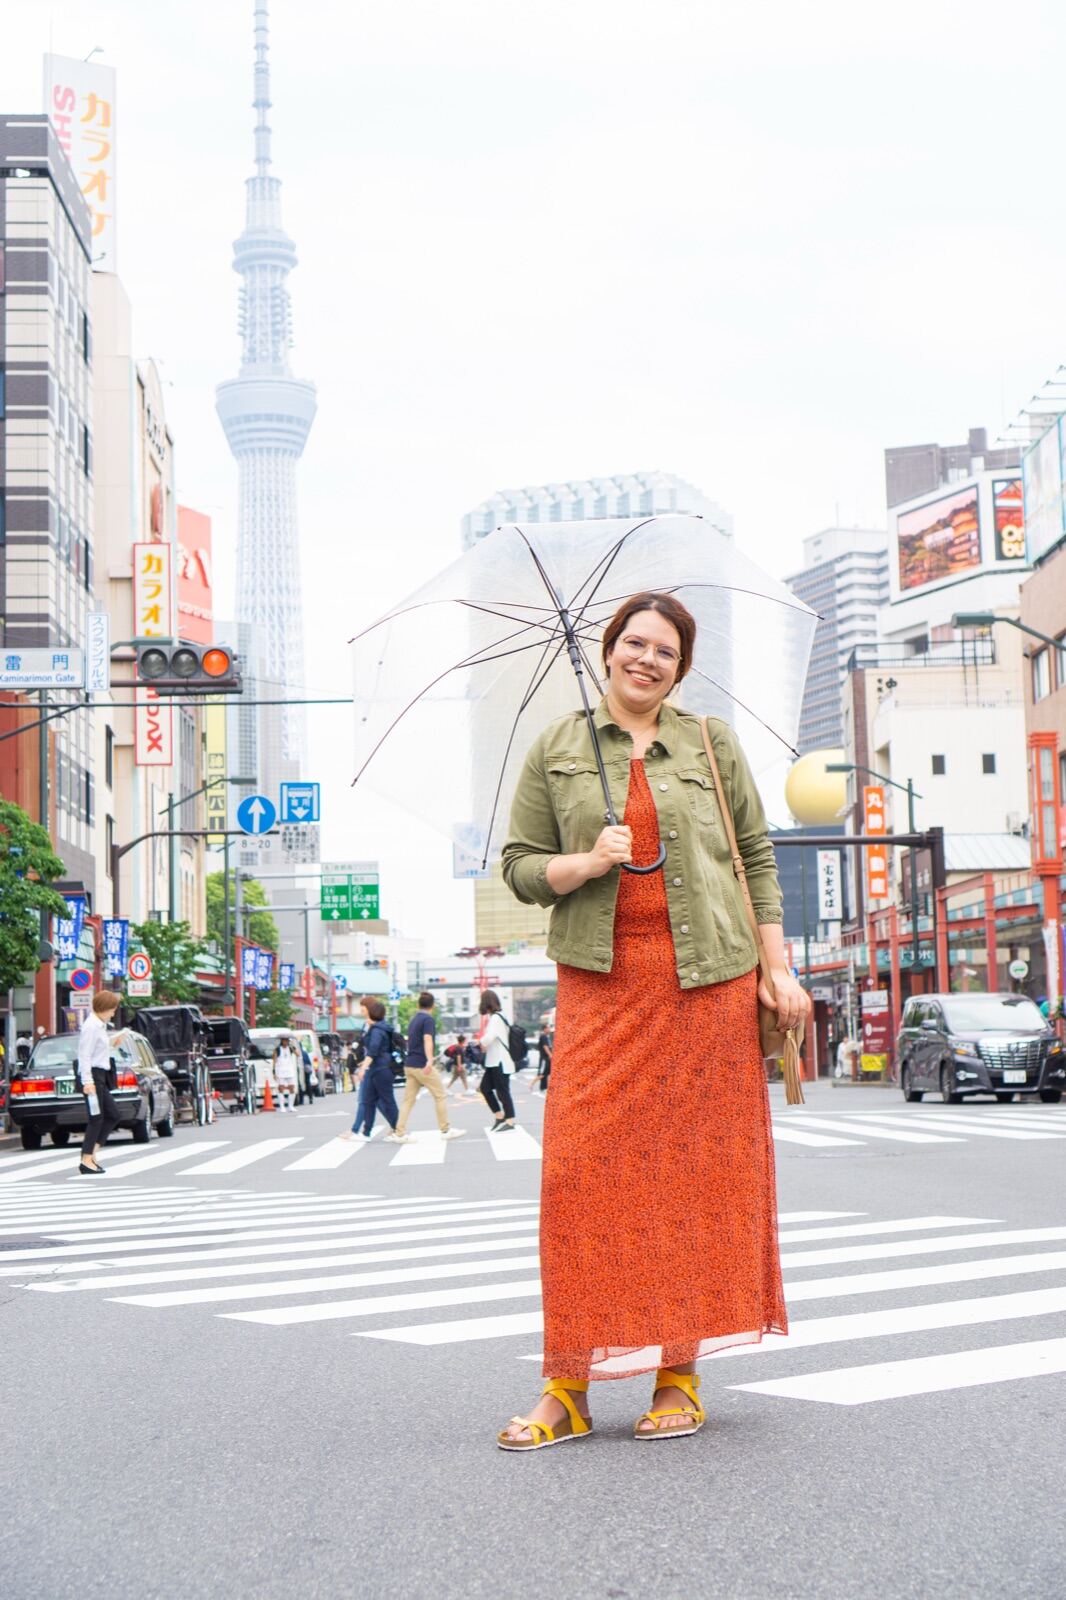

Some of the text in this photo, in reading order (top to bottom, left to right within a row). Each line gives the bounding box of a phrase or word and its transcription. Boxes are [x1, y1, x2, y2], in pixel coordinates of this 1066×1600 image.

[53, 84, 76, 161] SHI
[5, 655, 69, 671] 雷門
[92, 616, 104, 688] スクランブル式
[0, 673, 75, 682] Kaminarimon Gate
